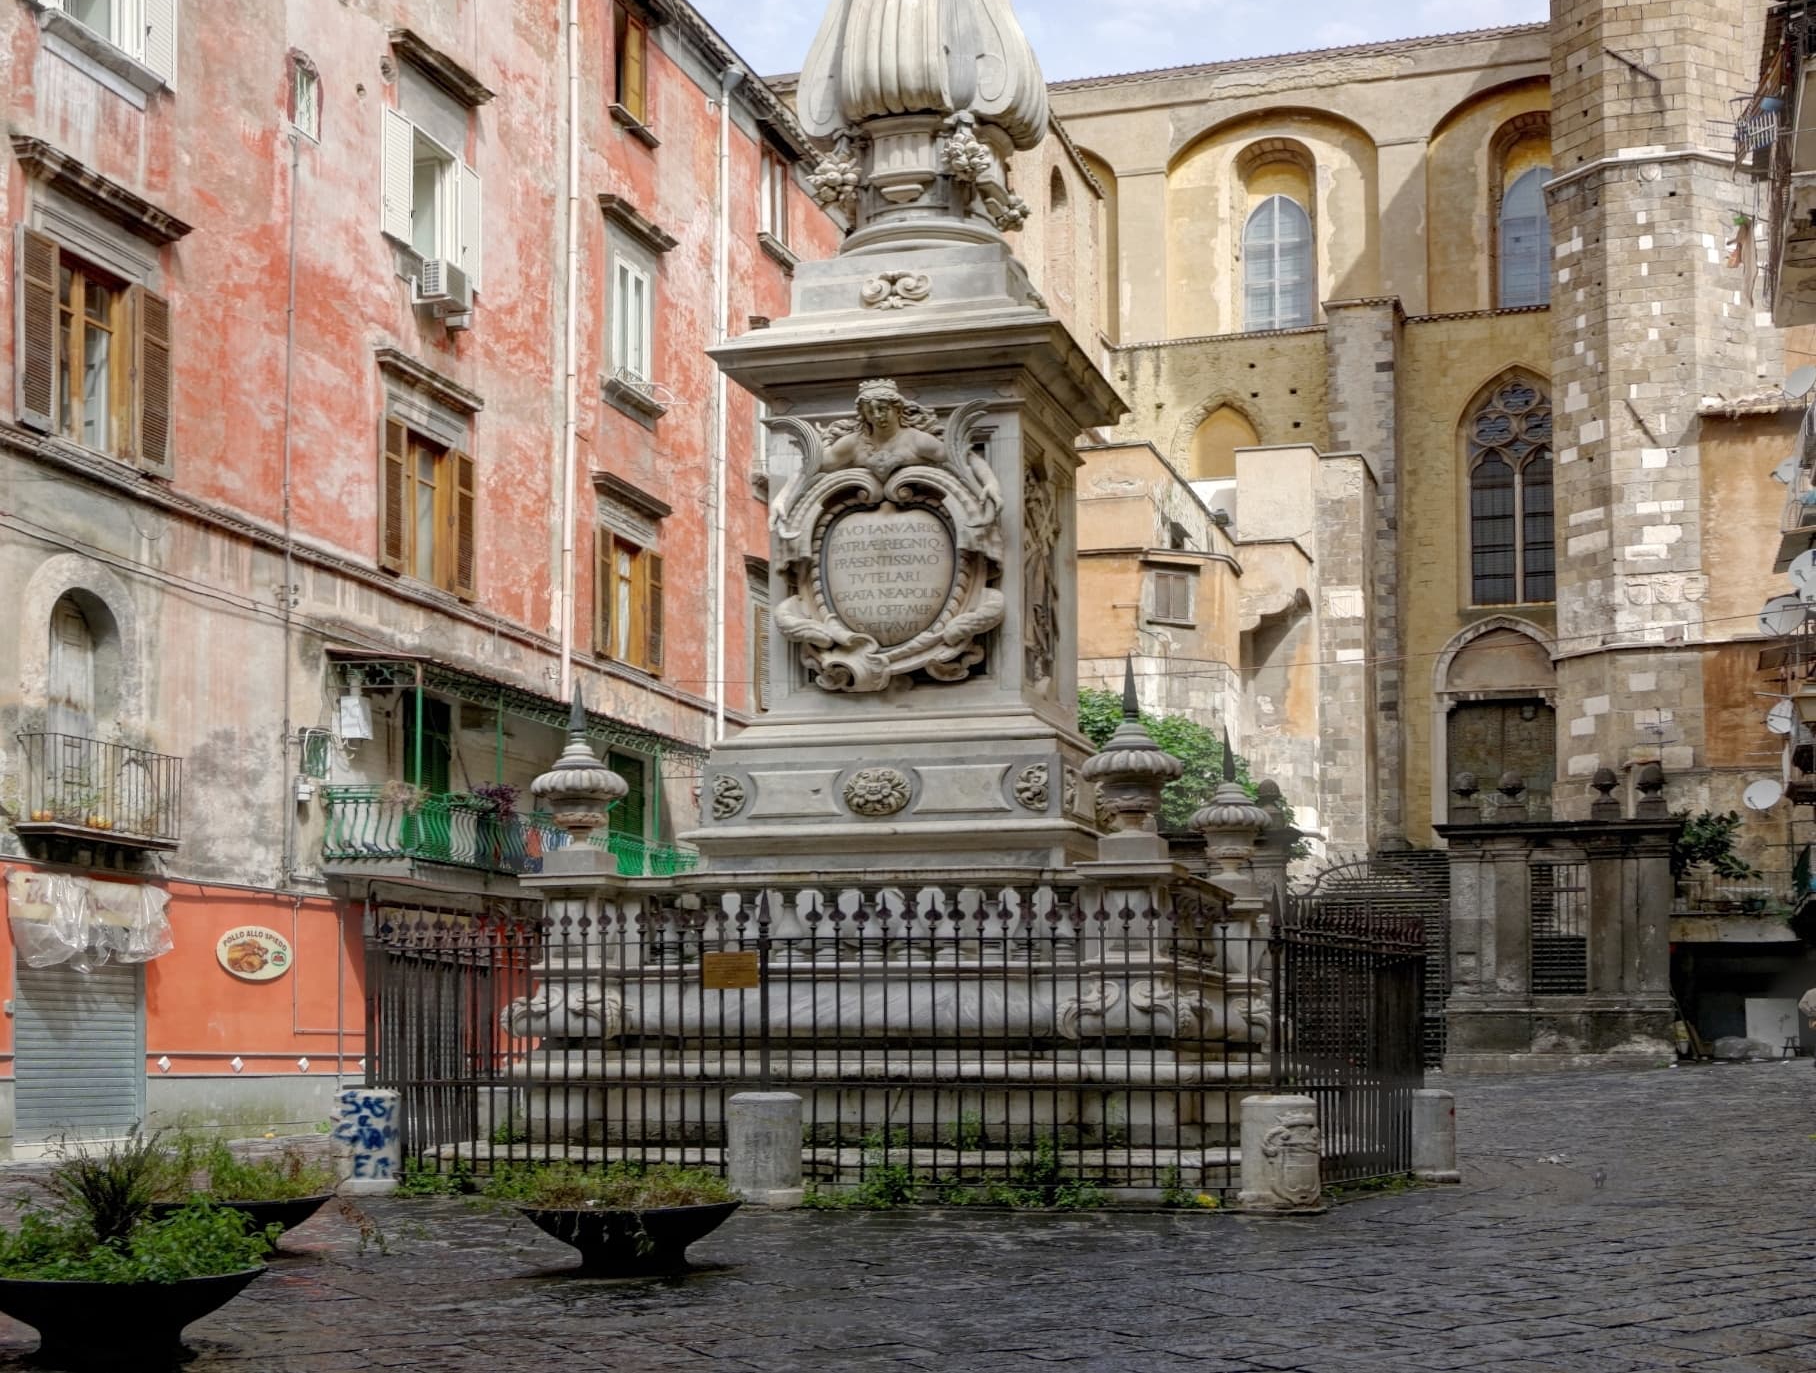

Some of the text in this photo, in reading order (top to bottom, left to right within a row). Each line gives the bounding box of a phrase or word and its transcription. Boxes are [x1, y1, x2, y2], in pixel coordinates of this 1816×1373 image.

[832, 523, 943, 539] DIVO IANVARIO
[848, 571, 920, 584] TVTELARI
[835, 587, 942, 602] GRATA NEAPOLIS
[223, 931, 245, 947] POLLO
[266, 933, 288, 951] SPIEDO
